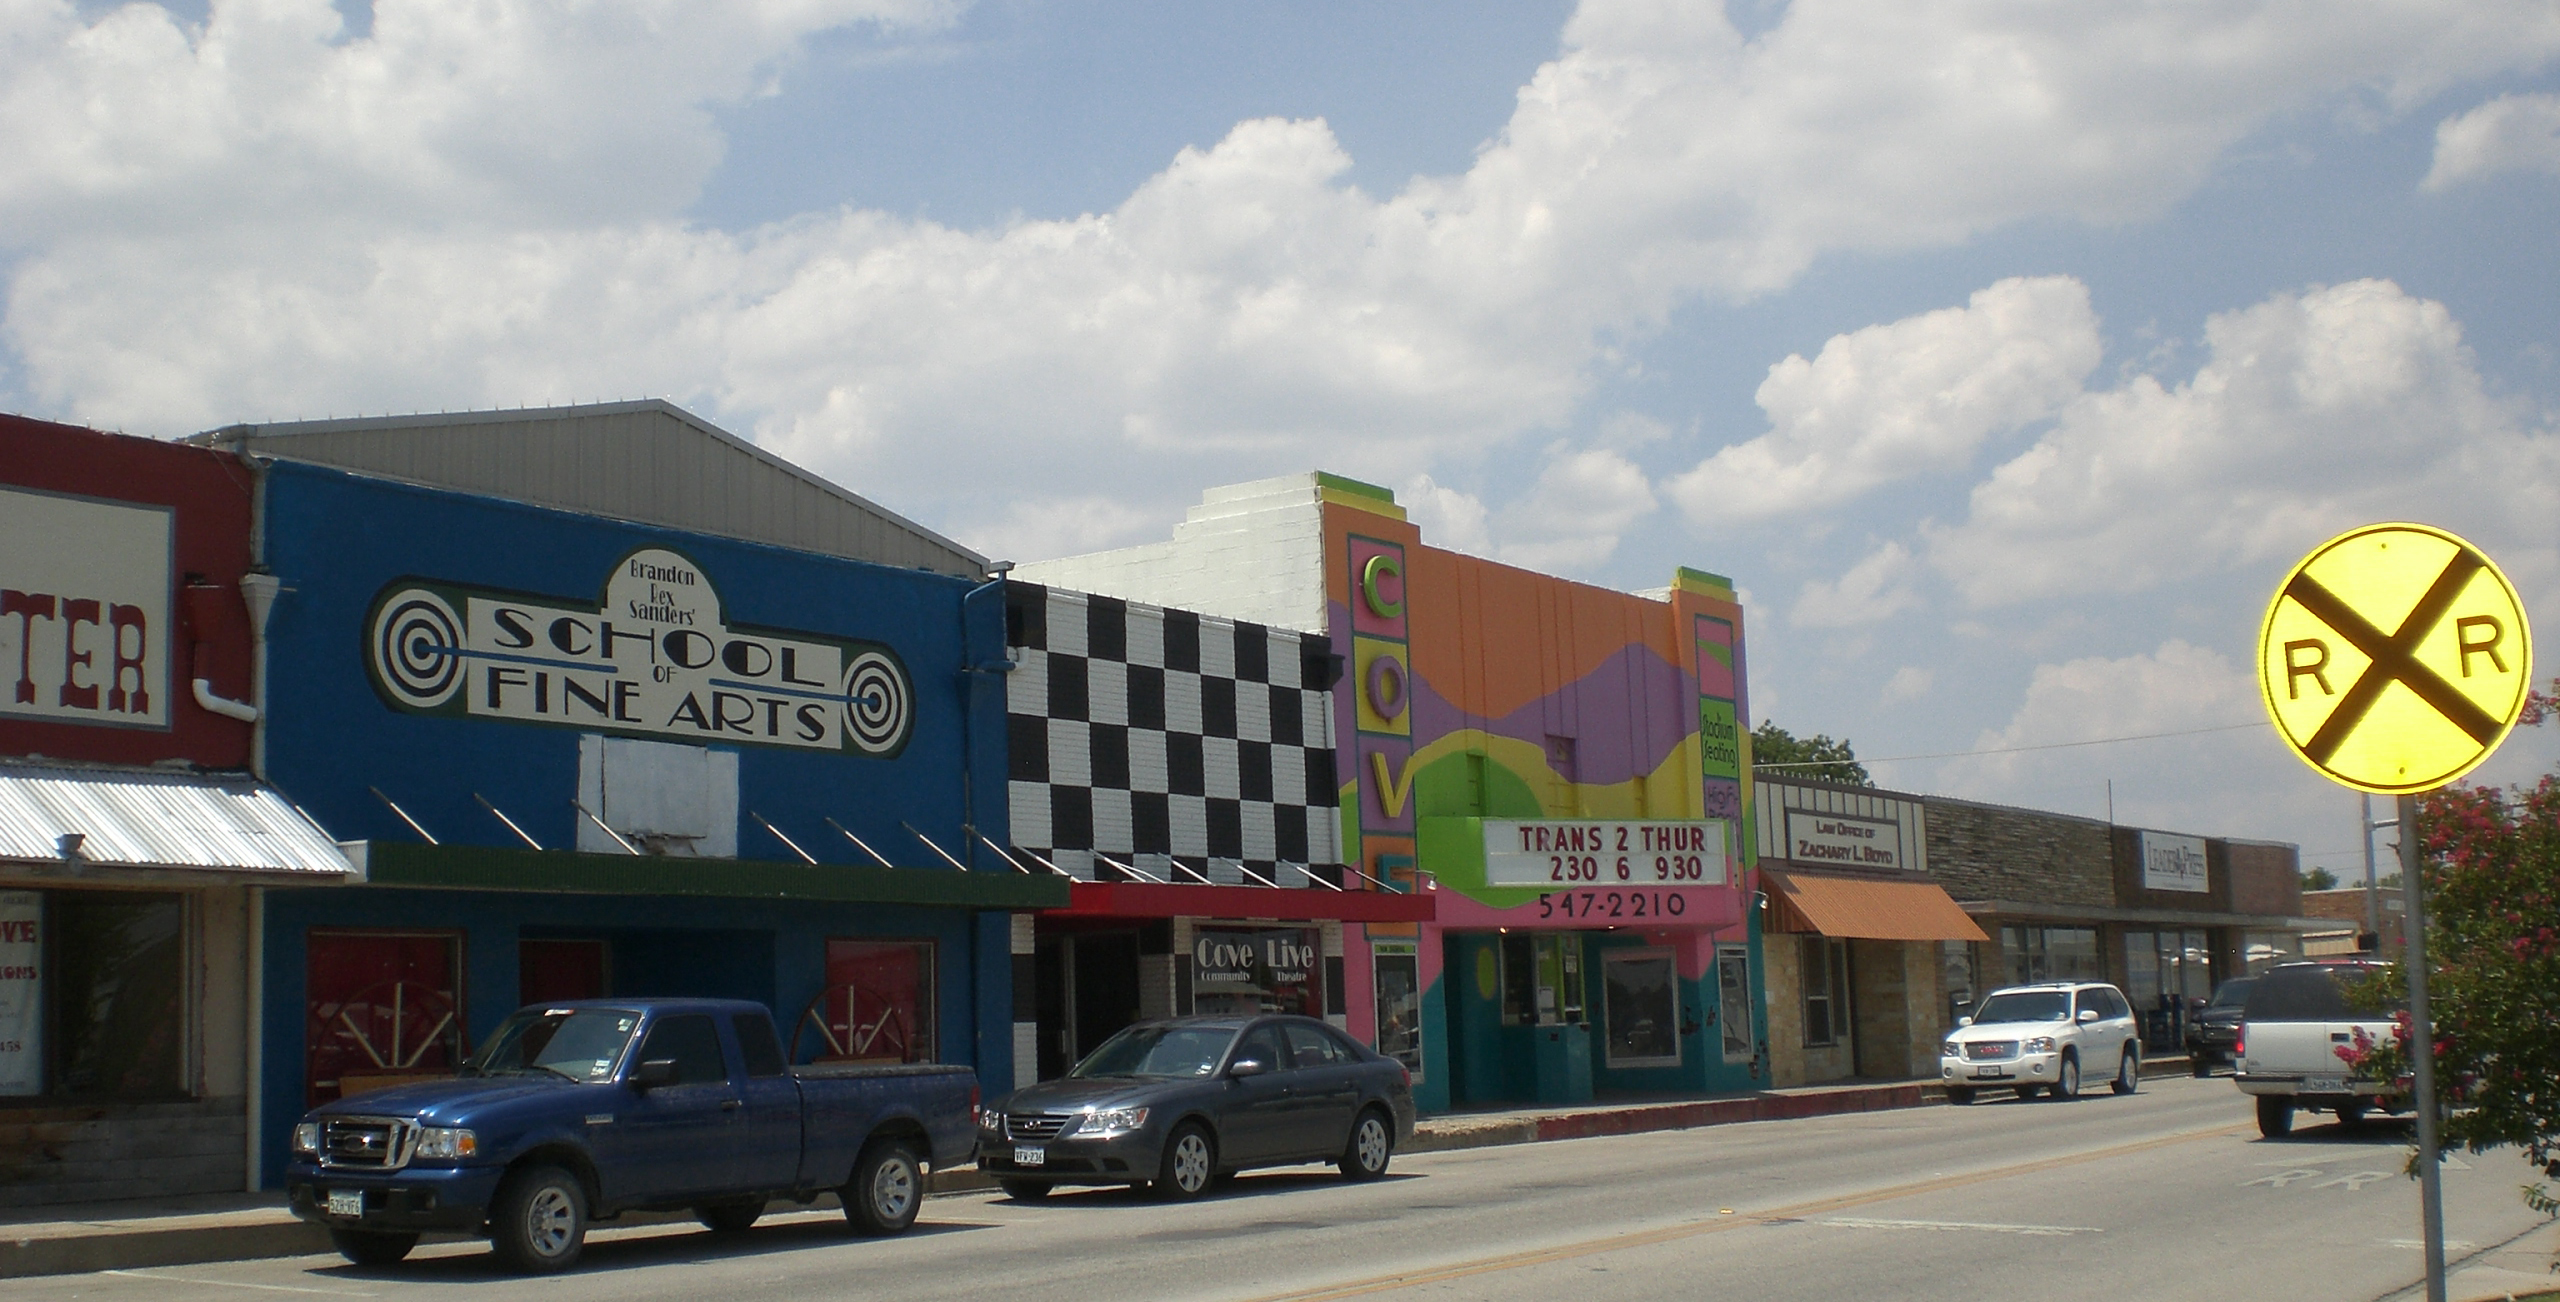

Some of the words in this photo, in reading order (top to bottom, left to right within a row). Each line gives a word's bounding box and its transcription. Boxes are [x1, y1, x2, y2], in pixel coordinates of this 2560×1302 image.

[630, 559, 695, 586] Brandon
[650, 583, 675, 606] Rex
[629, 600, 696, 626] Sanders'
[0, 590, 149, 715] TER
[493, 608, 825, 688] SCHOOL
[2284, 637, 2336, 700] R
[2456, 614, 2510, 678] R
[653, 665, 677, 684] OF
[487, 666, 643, 723] FINE
[666, 691, 826, 742] ARTS
[1702, 713, 1734, 739] Stadium
[1703, 741, 1736, 769] Seating
[1519, 826, 1603, 852] TRANS
[1616, 827, 1629, 852] 2
[1641, 826, 1706, 852] THUR
[1550, 856, 1599, 881] 230
[1616, 856, 1631, 881] 6
[1655, 855, 1703, 881] 930
[1539, 892, 1686, 919] 547-2210
[0, 920, 37, 944] VE
[1197, 938, 1254, 969] Cove
[1266, 938, 1314, 969] Live
